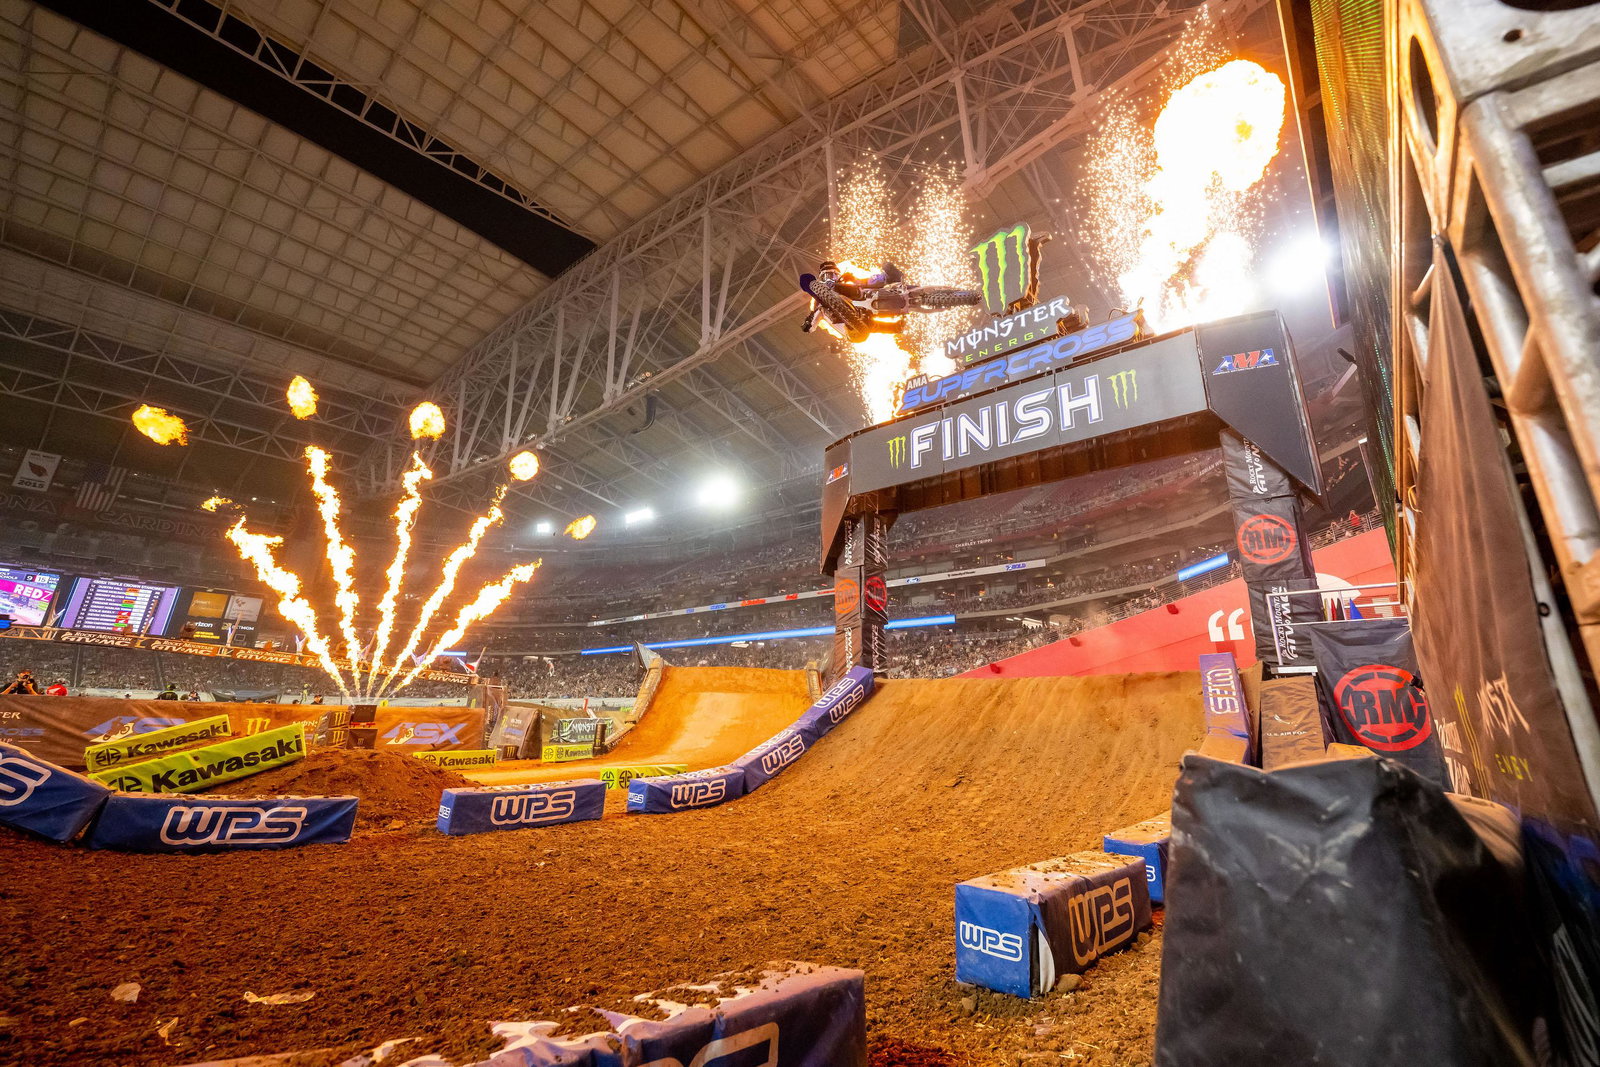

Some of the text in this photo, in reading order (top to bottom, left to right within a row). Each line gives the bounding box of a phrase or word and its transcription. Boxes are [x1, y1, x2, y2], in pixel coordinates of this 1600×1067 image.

[947, 298, 1070, 355] MONSTER
[966, 327, 1050, 363] ENERGY
[1213, 348, 1277, 373] AMA
[901, 314, 1138, 411] SUPERCROSS
[907, 376, 929, 391] AMA
[911, 376, 1104, 470] FINISH
[17, 480, 46, 489] 2015
[1247, 464, 1257, 485] ROCKY
[94, 511, 227, 540] CARDINA
[1248, 527, 1286, 551] RM
[97, 634, 133, 642] MOUNTAIN
[1277, 626, 1287, 649] ROCKY
[813, 677, 856, 709] WPS
[829, 684, 865, 723] WPS
[1350, 687, 1417, 726] RM
[127, 721, 229, 759] Kawasaki
[572, 721, 595, 733] MONST
[152, 734, 304, 793] Kawasaki
[438, 754, 495, 767] Kawasaki
[761, 734, 805, 775] WPS
[489, 790, 577, 826] WPS
[628, 791, 644, 804] WPS
[671, 778, 727, 809] WPS
[160, 806, 308, 846] WPS
[438, 803, 451, 820] WPS
[1068, 877, 1135, 967] WPS
[960, 920, 1023, 962] WPS
